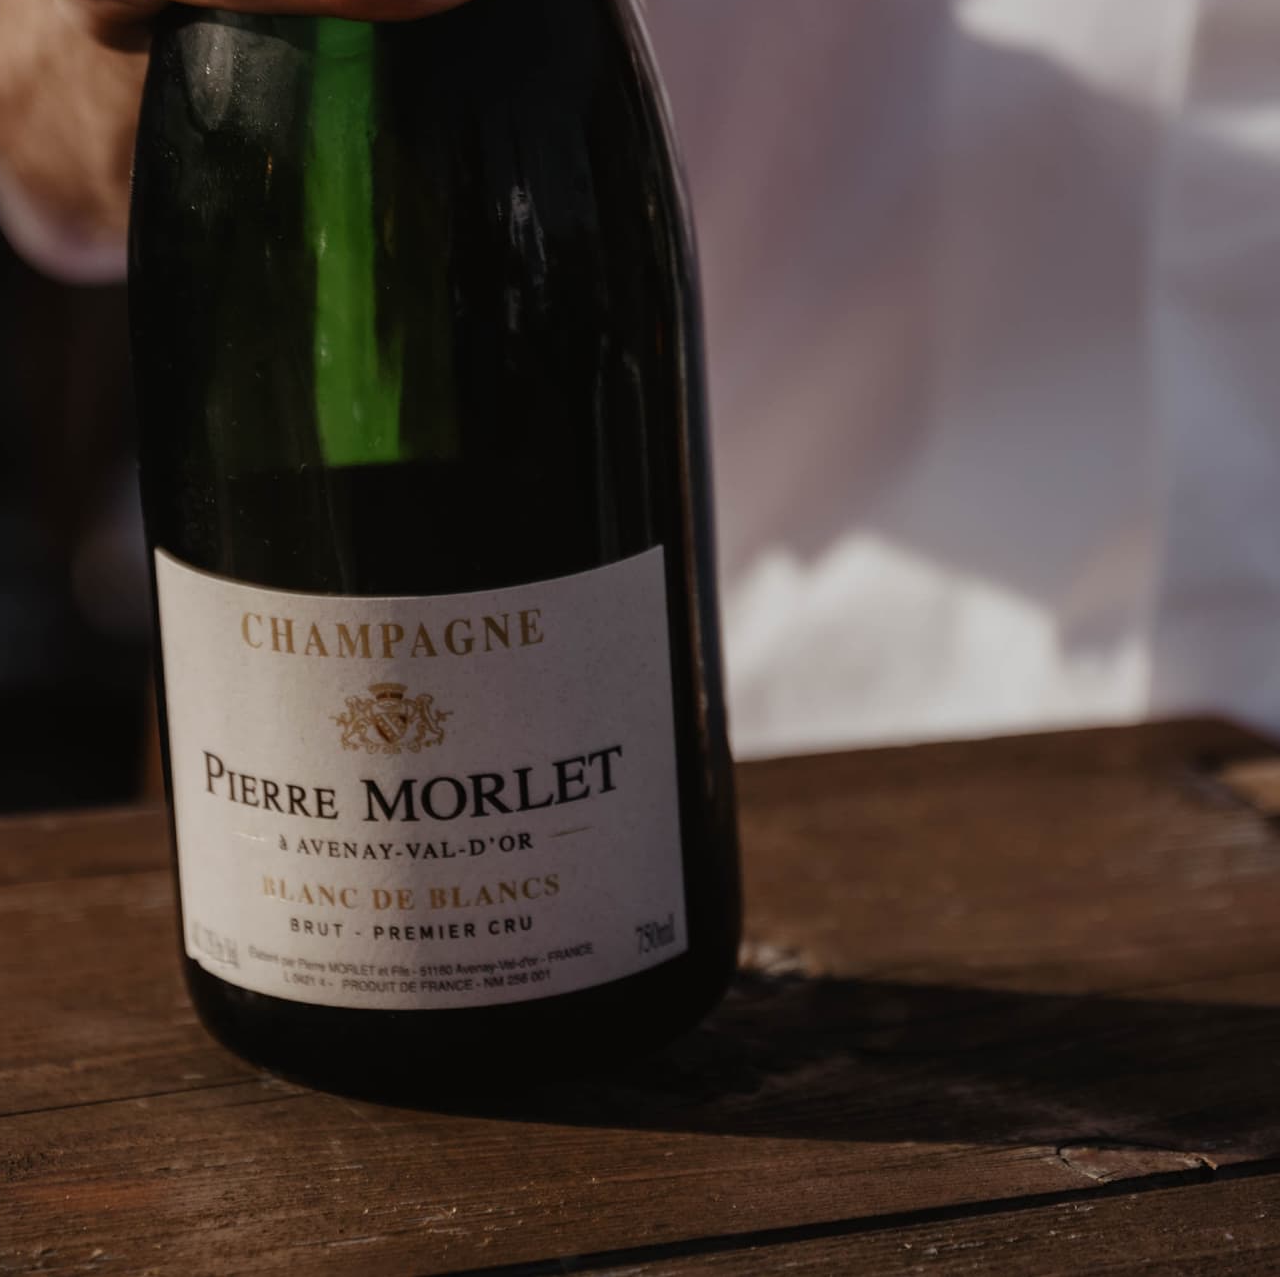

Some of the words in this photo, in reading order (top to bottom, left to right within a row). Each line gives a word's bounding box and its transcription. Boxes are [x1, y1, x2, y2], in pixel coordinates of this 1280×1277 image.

[240, 609, 544, 659] CHAMPAGNE
[202, 750, 339, 820] PIERRE
[360, 745, 623, 822] MORLET
[297, 833, 534, 860] AVENAY-VAL-D'OR
[262, 873, 359, 909] BLANC
[372, 888, 415, 910] DE
[430, 873, 560, 910] BLANCS
[289, 918, 344, 938] BRUT
[374, 923, 476, 941] PREMIER
[488, 916, 533, 935] CRU
[328, 961, 376, 976] MORLET
[547, 942, 594, 963] FRANCE
[342, 978, 396, 992] PRODUIT
[400, 981, 417, 993] DE
[420, 978, 473, 992] FRANCE
